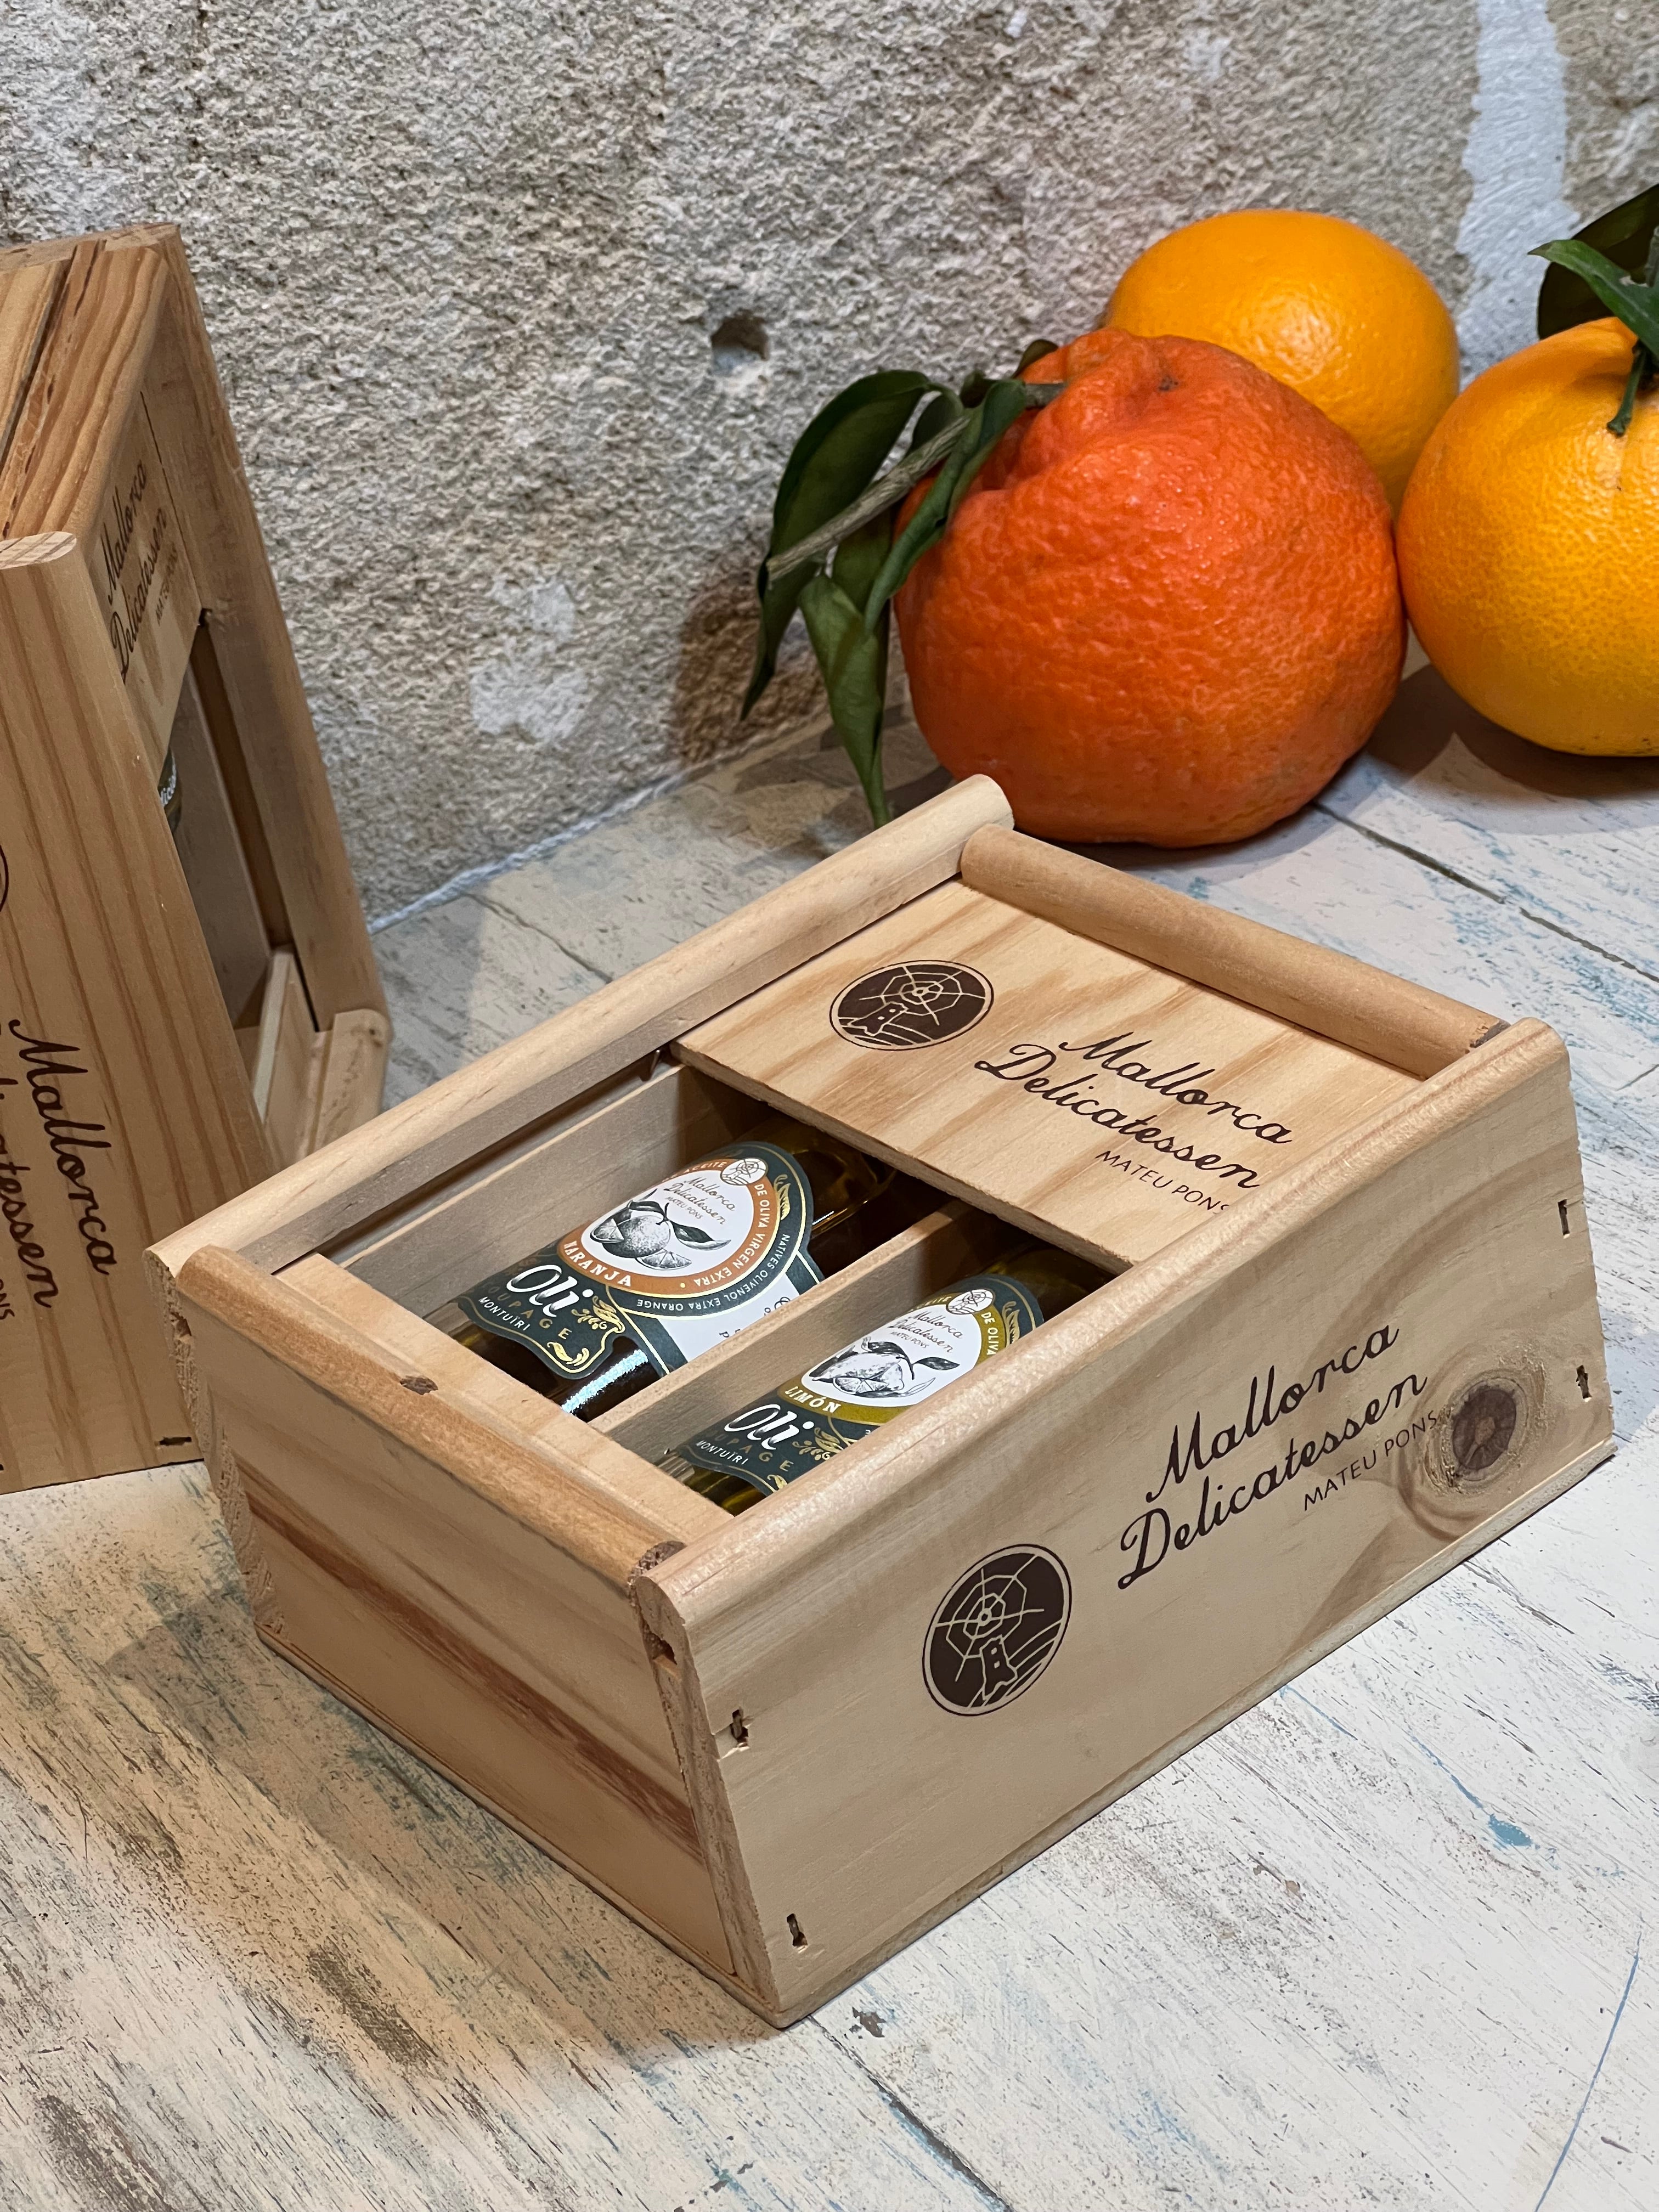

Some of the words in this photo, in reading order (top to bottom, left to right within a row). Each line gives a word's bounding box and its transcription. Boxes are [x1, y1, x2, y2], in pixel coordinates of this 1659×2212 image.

[100, 459, 146, 606] Mallorca
[110, 508, 167, 685] Delicatessen
[1058, 1031, 1293, 1145] Mallorca
[974, 1043, 1260, 1189] Delicatessen
[0, 1024, 59, 1308] tessen
[8, 1019, 118, 1276] Mallorca
[1094, 1150, 1173, 1188] MATEU
[663, 1182, 727, 1225] Delicatessen
[684, 1176, 737, 1211] Mallorca
[754, 1183, 768, 1197] DE
[757, 1200, 770, 1228] OLIVA
[563, 1240, 632, 1287] NARANJA
[732, 1233, 765, 1270] VIRGEN
[767, 1233, 791, 1269] NATIVES
[693, 1266, 733, 1286] EXTRA
[636, 1299, 684, 1311] ORANGE
[689, 1299, 721, 1310] EXTRA
[981, 1312, 996, 1325] DE
[888, 1319, 955, 1353] Delicatessen
[908, 1311, 963, 1339] Mallorca
[987, 1327, 1000, 1356] OLIVA
[784, 1385, 842, 1414] LIMÓN
[1146, 1324, 1400, 1504] Mallorca
[705, 1430, 794, 1472] UPAGE
[1304, 1449, 1377, 1511] MATEU
[1384, 1410, 1437, 1458] PONS
[1117, 1375, 1429, 1590] Delicatessen
